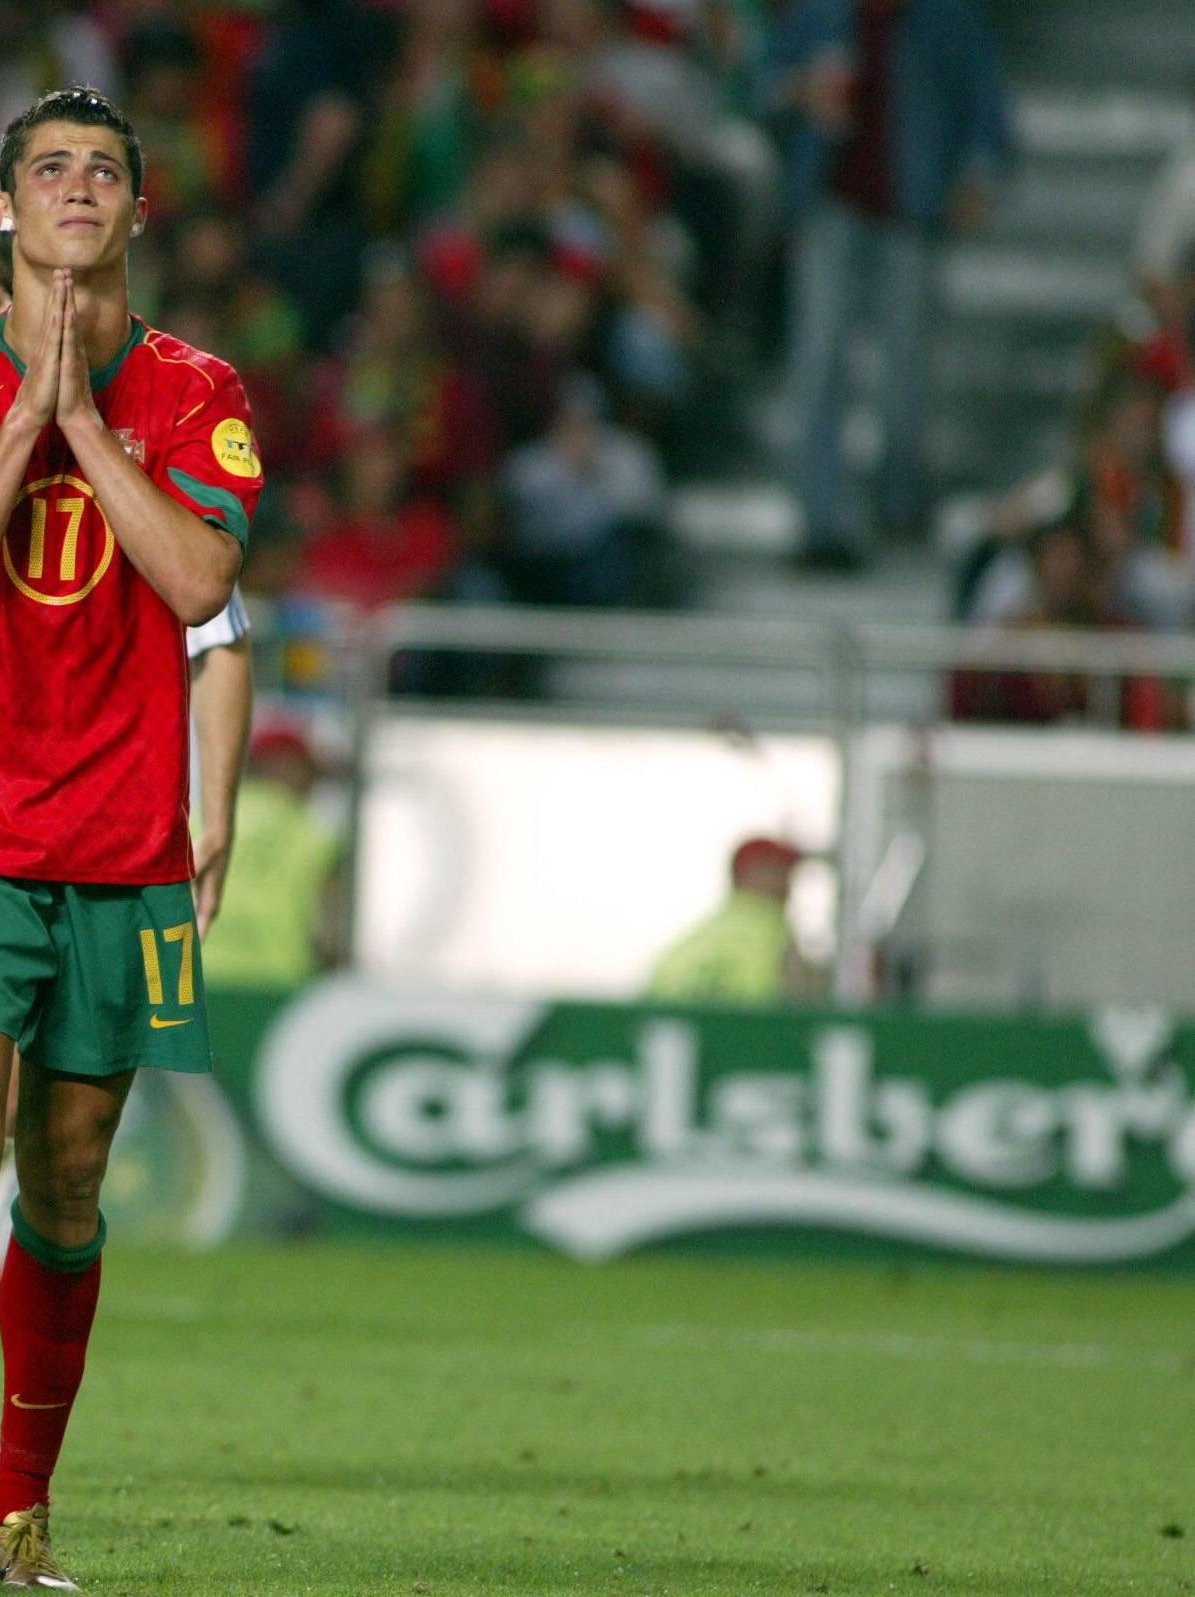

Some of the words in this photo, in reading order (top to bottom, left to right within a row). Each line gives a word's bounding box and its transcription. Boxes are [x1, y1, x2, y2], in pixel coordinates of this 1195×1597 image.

[28, 497, 85, 581] 17
[139, 921, 194, 1006] 17
[254, 966, 1195, 1262] Carlsber
